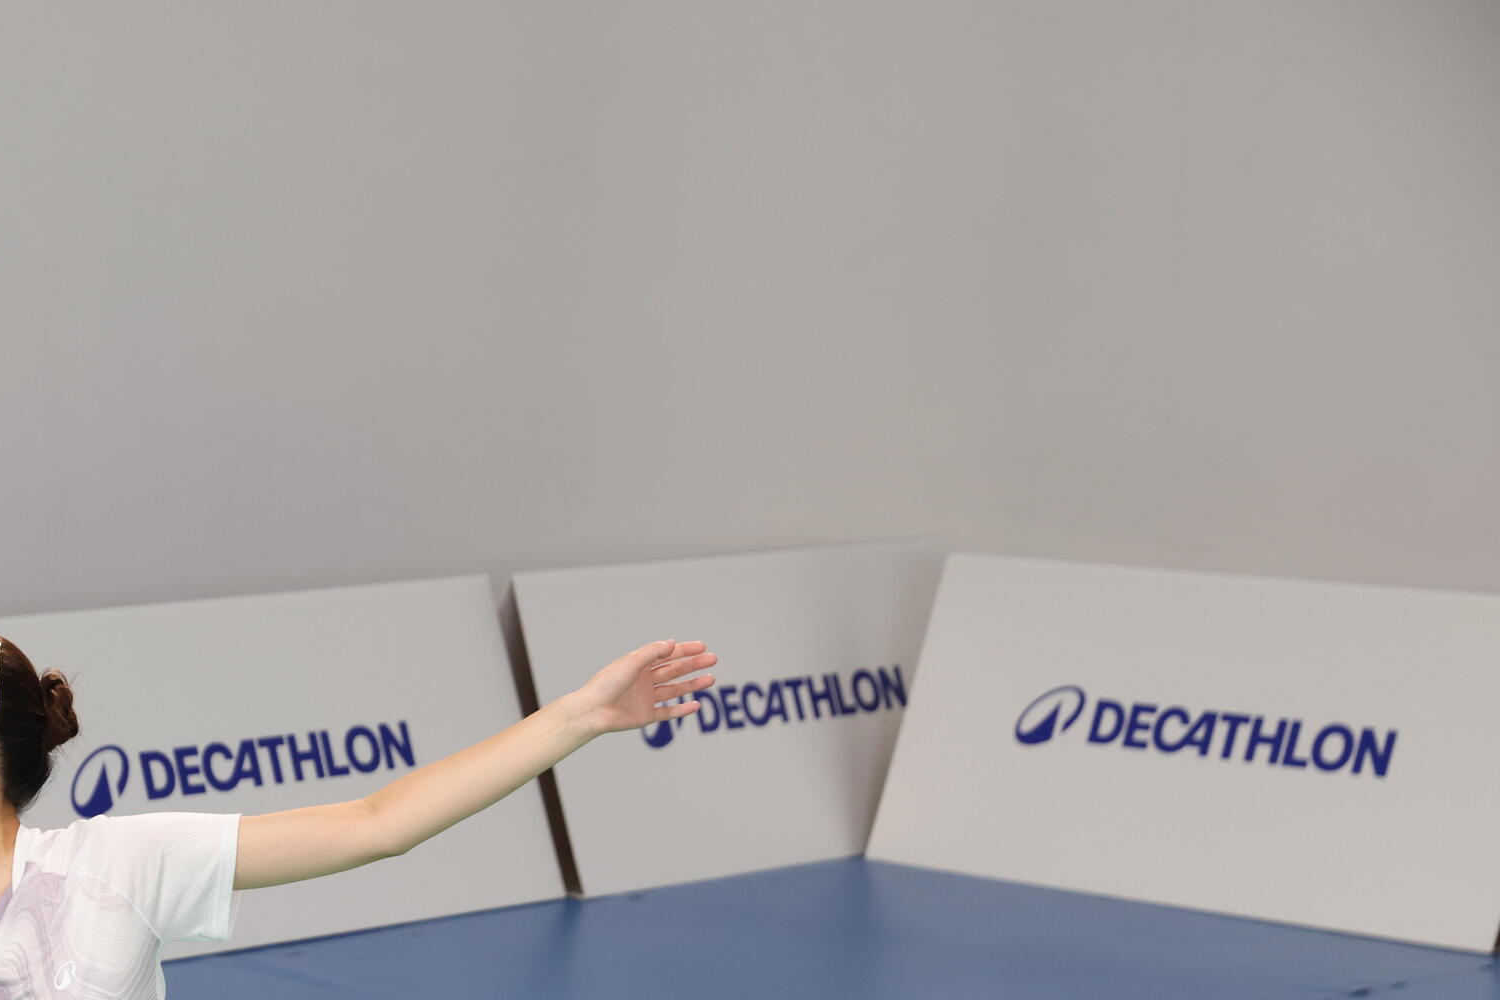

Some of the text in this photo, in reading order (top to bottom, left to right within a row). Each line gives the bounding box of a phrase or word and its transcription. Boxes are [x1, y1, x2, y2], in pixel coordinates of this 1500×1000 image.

[693, 664, 908, 734] DECATHLON
[1087, 699, 1397, 778] DECATHLON
[138, 721, 417, 800] DECATHLON
